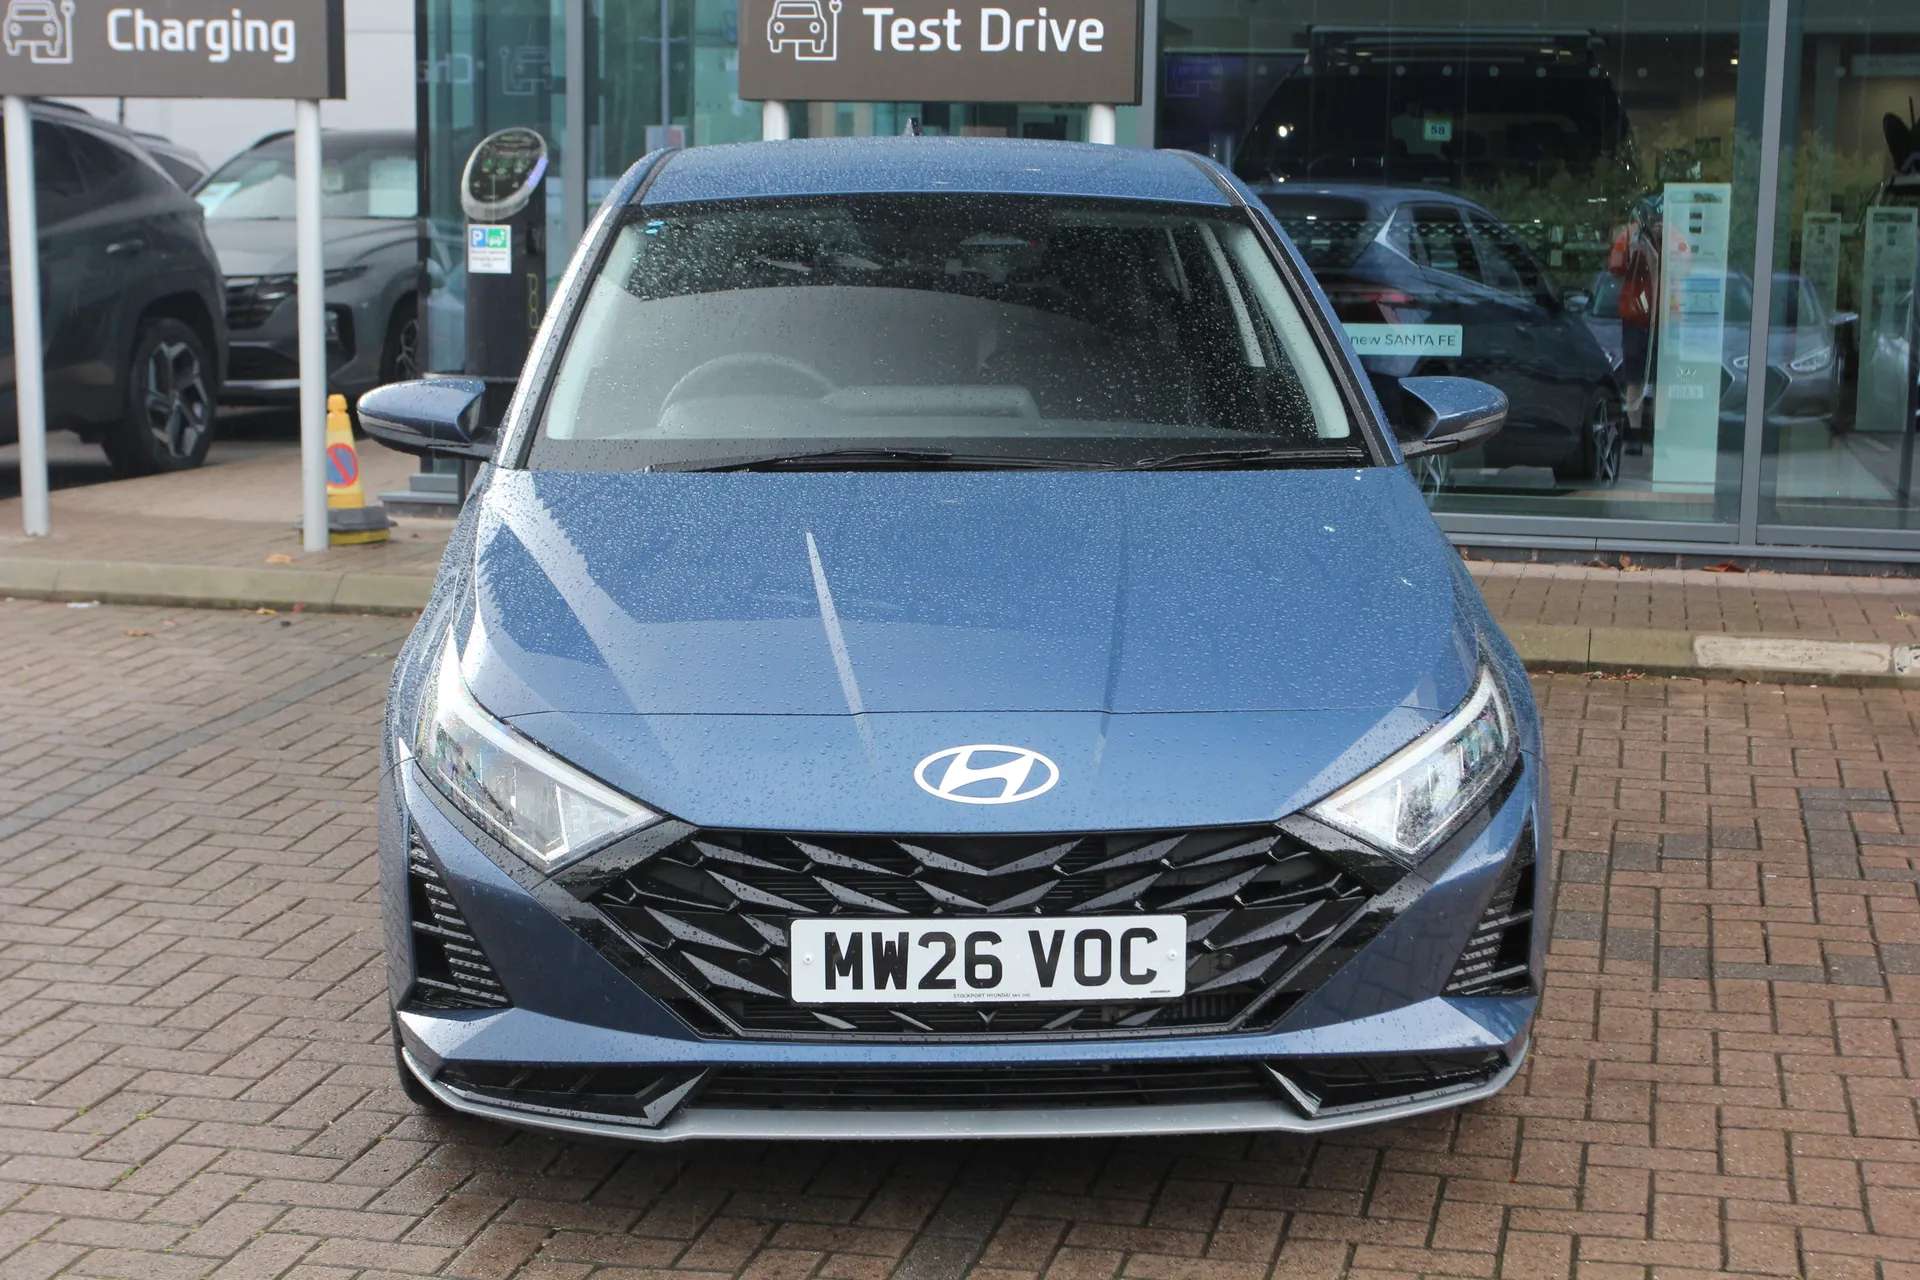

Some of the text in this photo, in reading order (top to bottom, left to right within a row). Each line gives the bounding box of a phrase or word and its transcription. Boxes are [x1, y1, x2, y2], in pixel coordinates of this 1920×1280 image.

[107, 8, 295, 63] Charging
[862, 7, 1104, 51] Test Drive
[1385, 334, 1434, 346] SANTA
[1438, 335, 1456, 346] FE
[825, 927, 1158, 990] MW26 VOC
